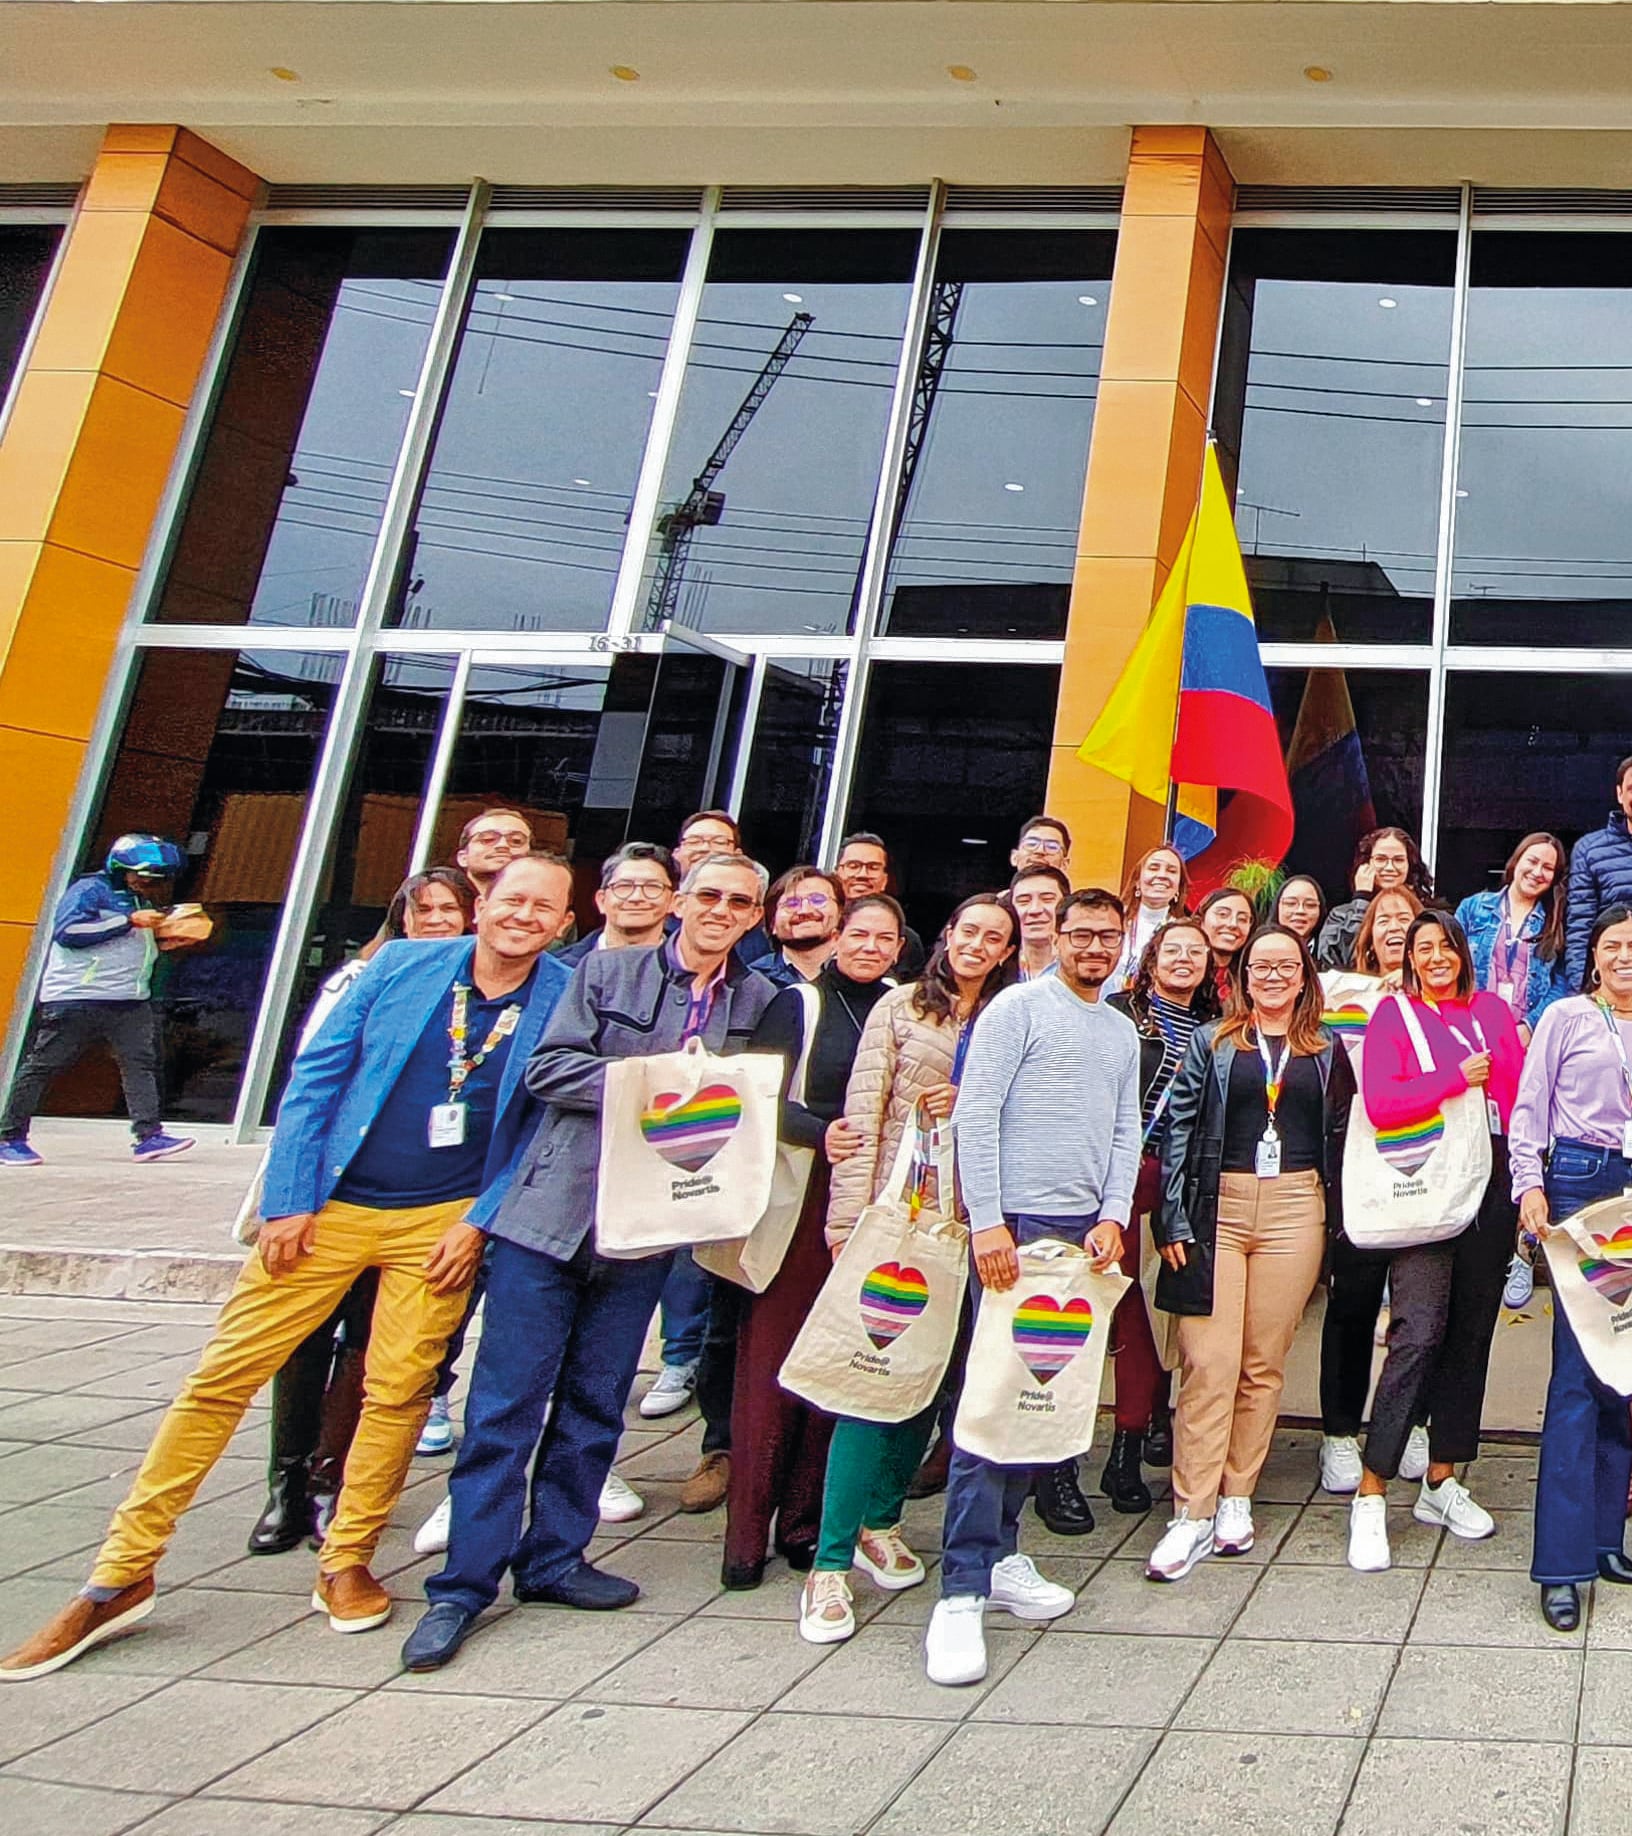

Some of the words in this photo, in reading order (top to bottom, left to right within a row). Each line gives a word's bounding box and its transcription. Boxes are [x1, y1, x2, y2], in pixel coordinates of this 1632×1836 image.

[671, 1175, 713, 1190] Pride@
[671, 1184, 720, 1201] Novartis
[853, 1350, 891, 1366] Pride@
[848, 1359, 891, 1376] Novartis
[1020, 1390, 1054, 1401] Pride@
[1017, 1401, 1056, 1412] Novartis
